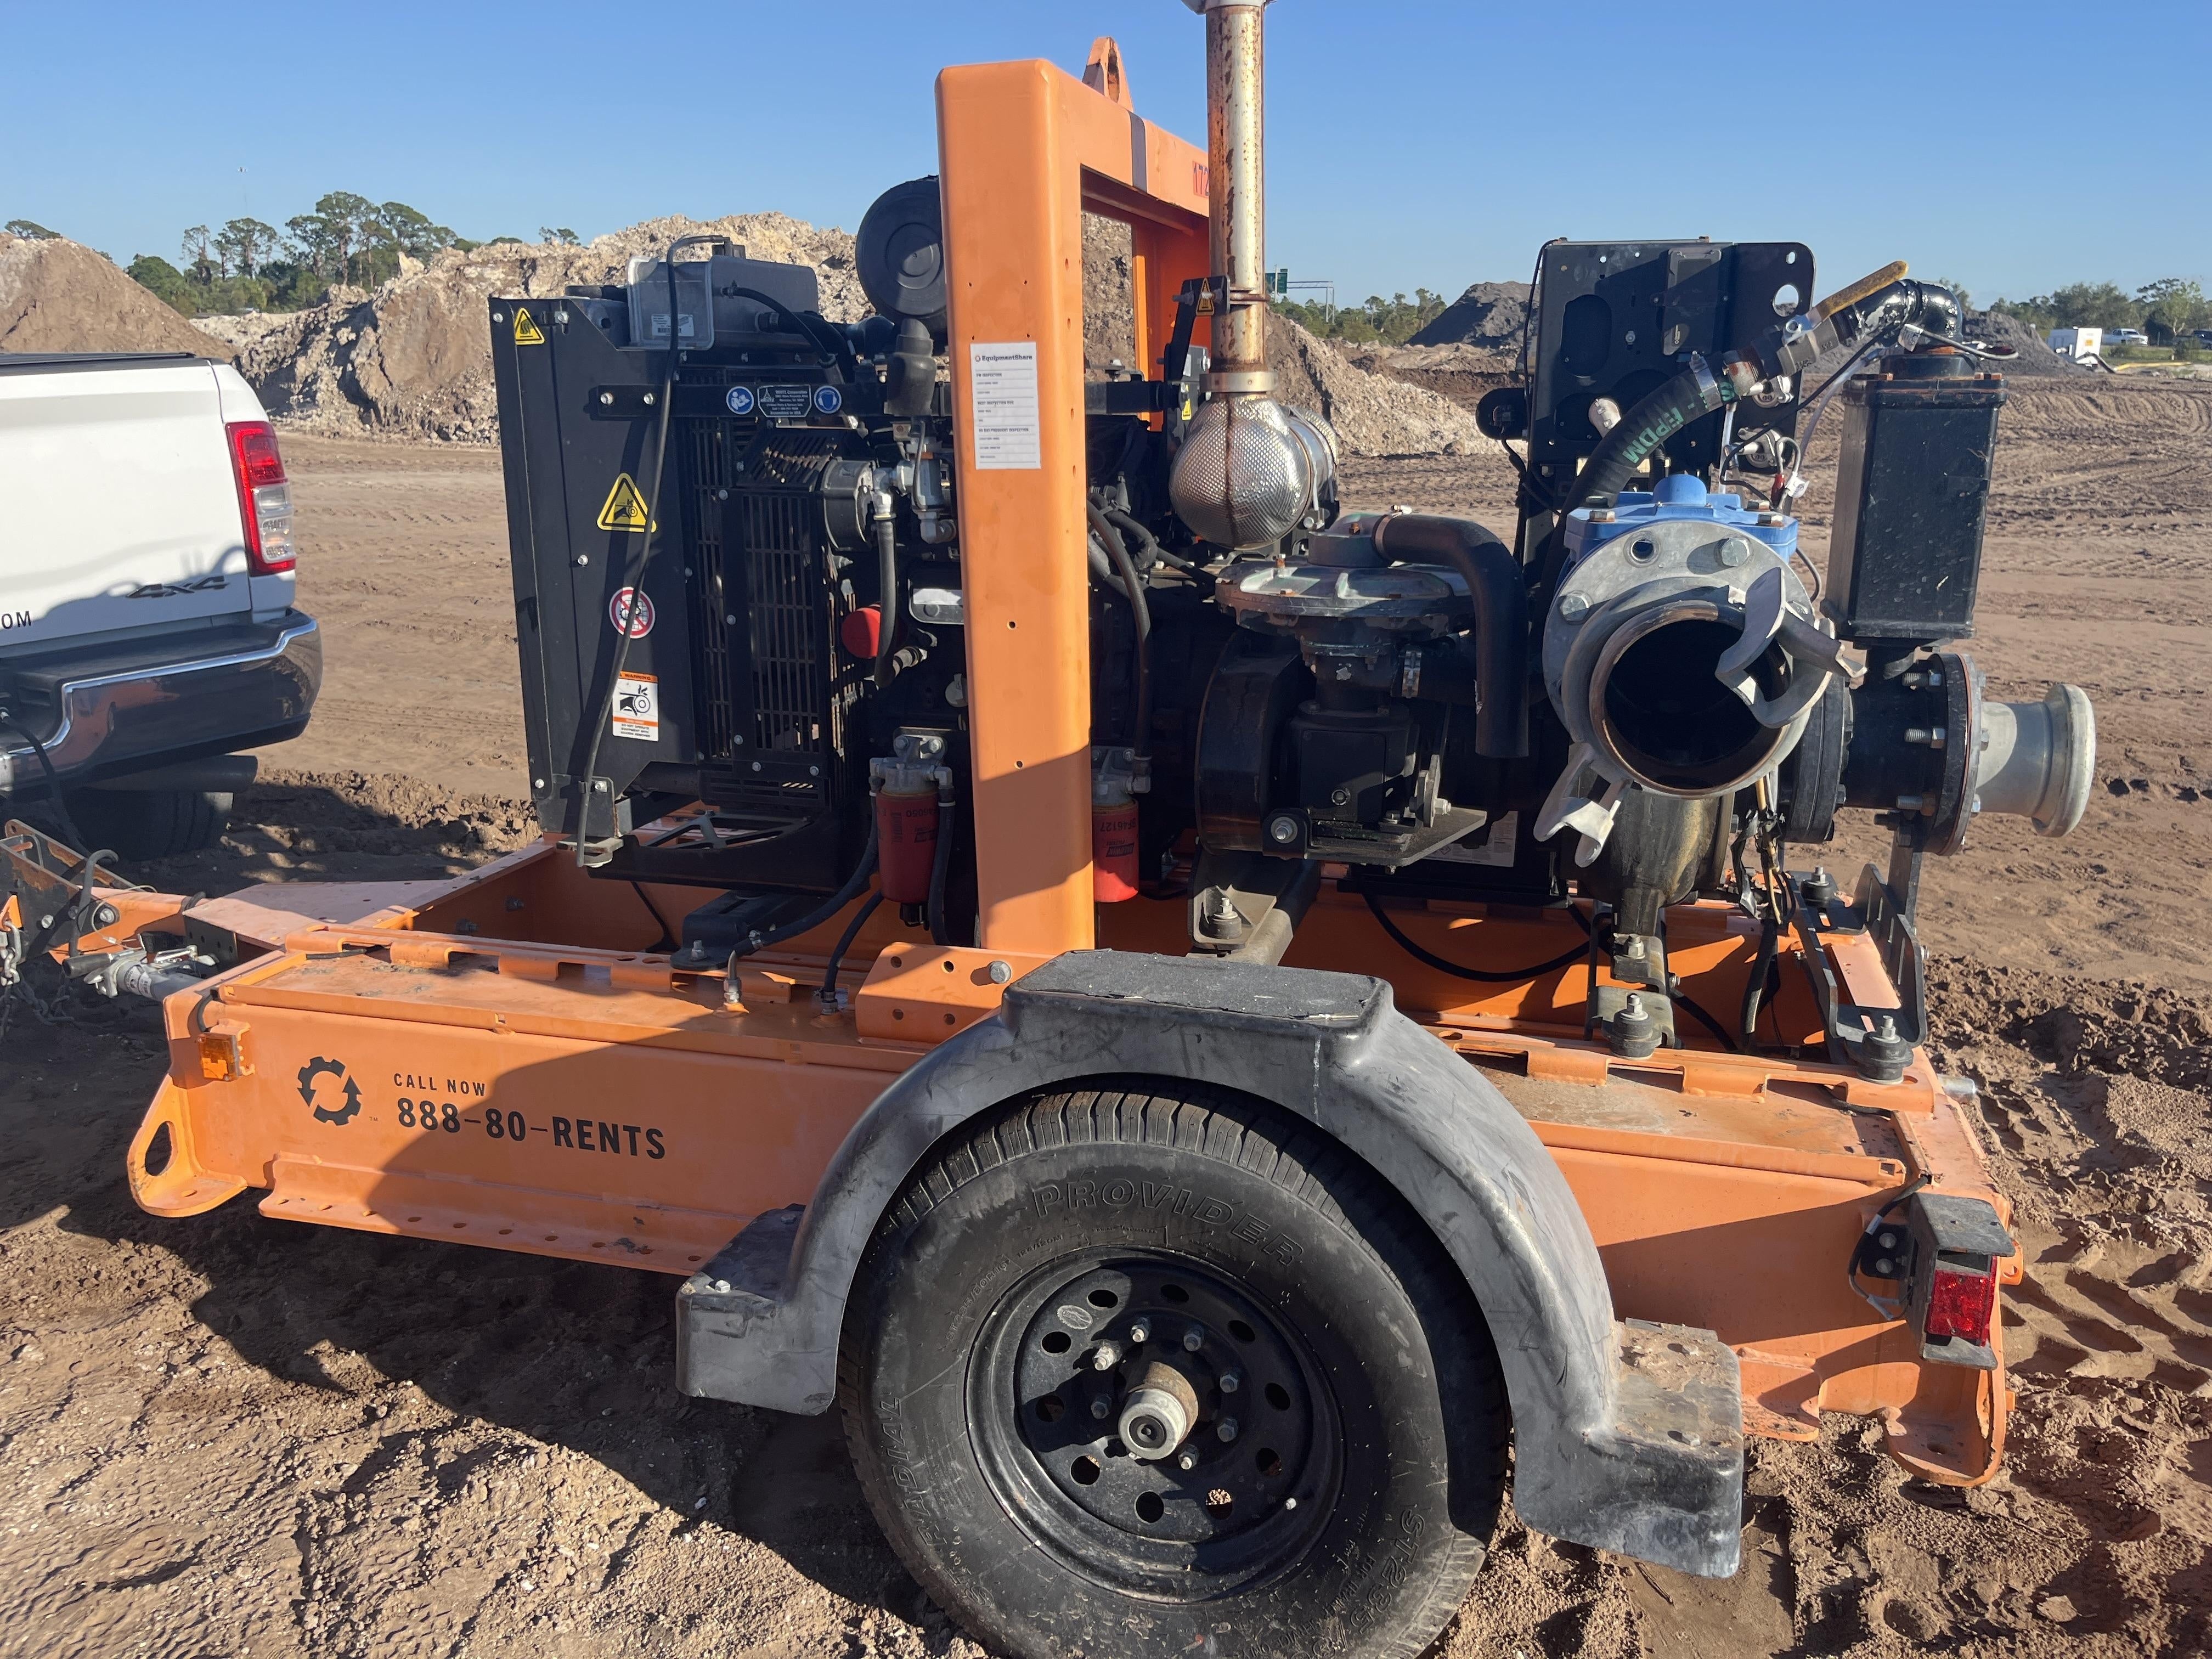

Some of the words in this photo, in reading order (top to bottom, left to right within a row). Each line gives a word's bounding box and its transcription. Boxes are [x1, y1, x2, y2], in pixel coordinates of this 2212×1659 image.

[1622, 407, 1684, 464] EPDM
[394, 1073, 438, 1091] CALL
[447, 1079, 485, 1096] NOW
[397, 1098, 665, 1160] 888-80-RENTS
[1032, 1178, 1304, 1266] PROVIDER
[880, 1397, 948, 1546] RADIAL
